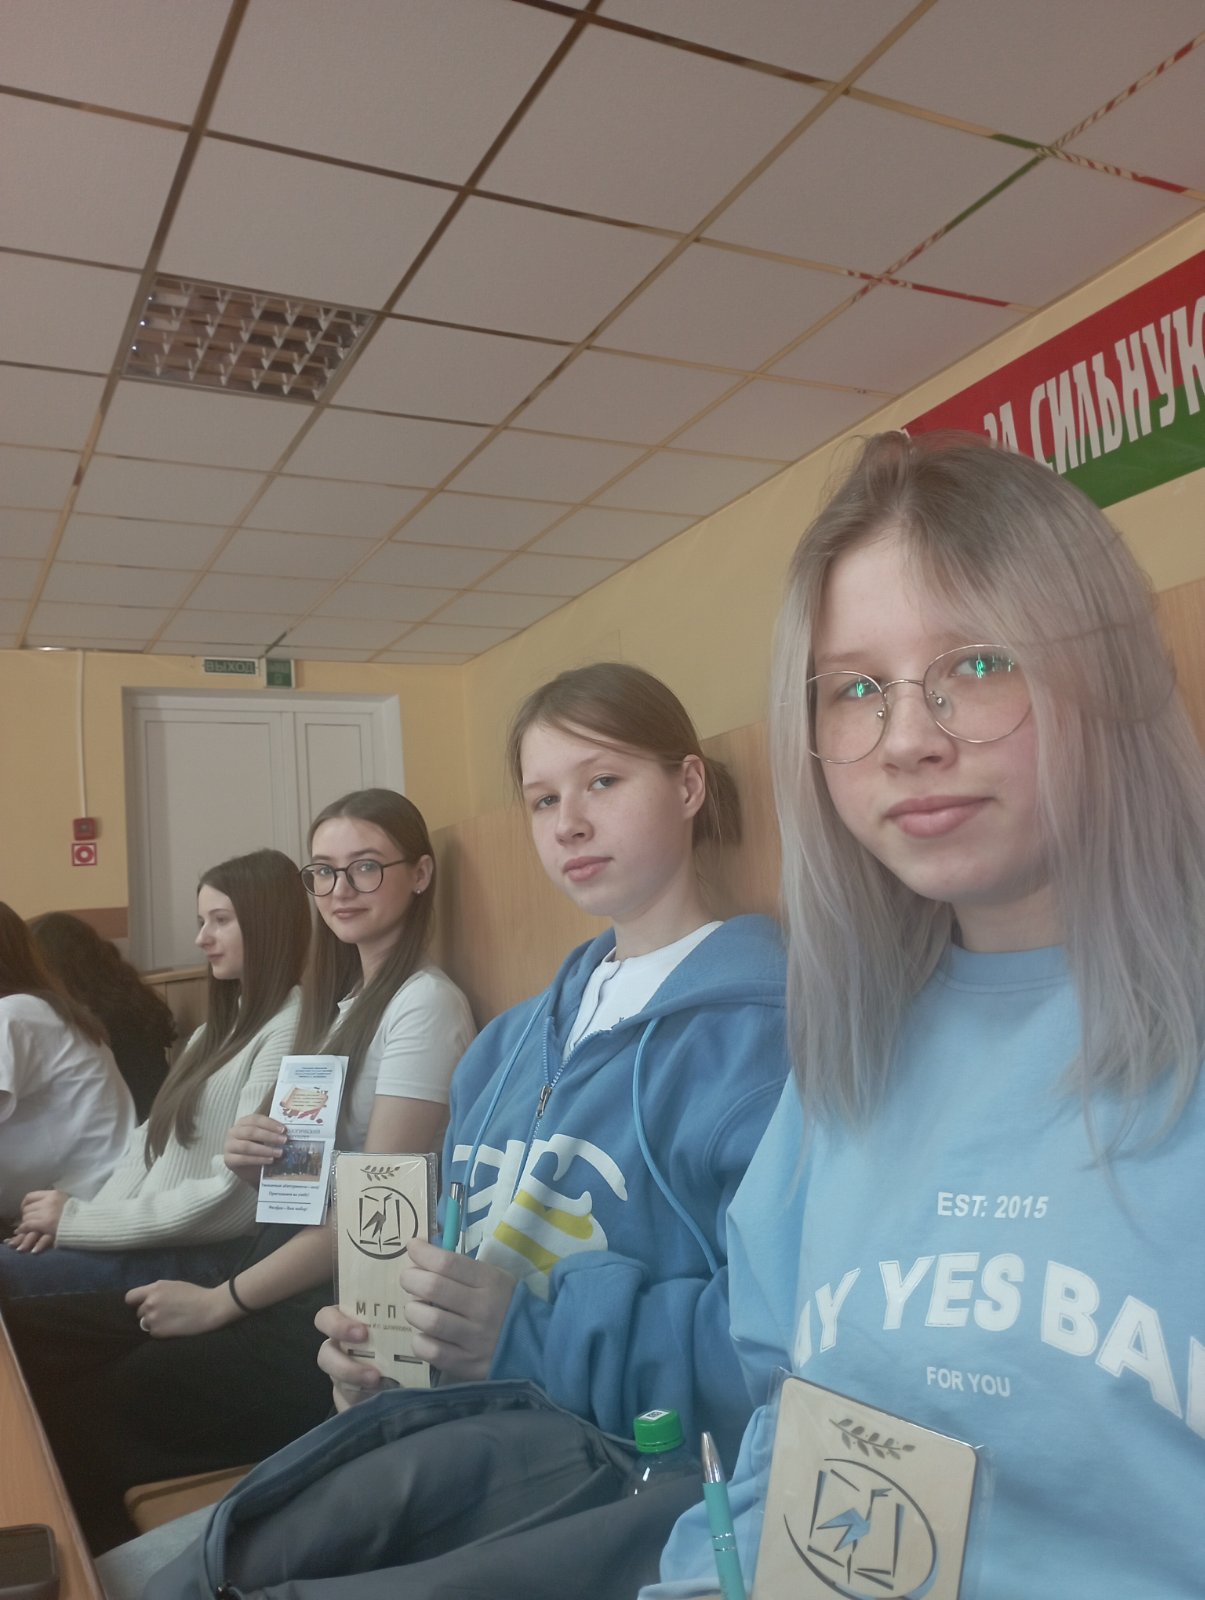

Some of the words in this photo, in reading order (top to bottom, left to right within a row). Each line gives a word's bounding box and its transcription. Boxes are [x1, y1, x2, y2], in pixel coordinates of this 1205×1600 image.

[206, 660, 254, 673] ВЫХОД
[994, 1195, 1049, 1219] 2015
[879, 1252, 1025, 1332] YES
[356, 1301, 405, 1319] МГП
[927, 1366, 964, 1392] FOR
[967, 1372, 1011, 1398] YOU
